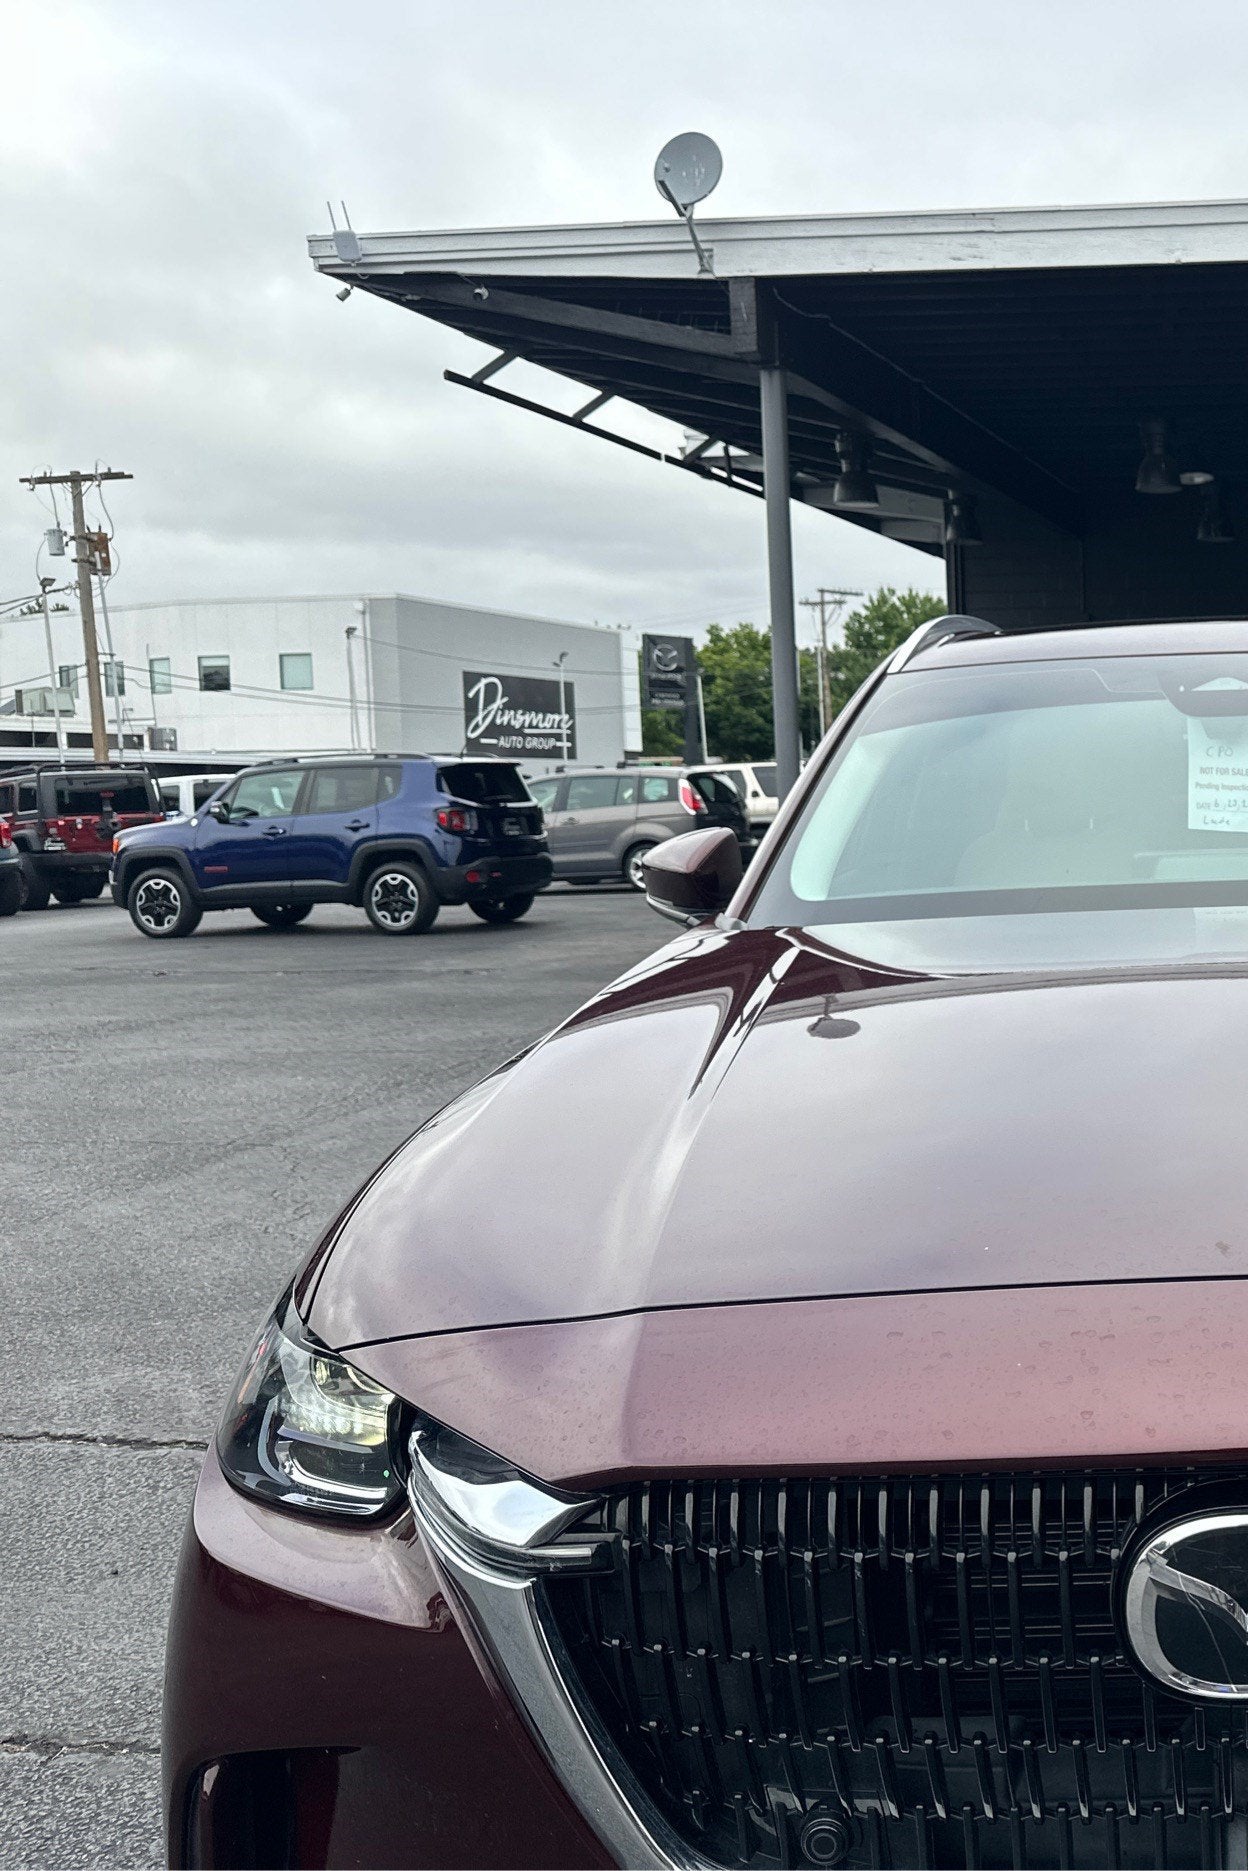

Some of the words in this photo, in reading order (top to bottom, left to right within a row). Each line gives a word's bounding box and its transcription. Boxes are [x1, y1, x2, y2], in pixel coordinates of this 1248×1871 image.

[467, 676, 574, 739] Dinsmore
[498, 735, 524, 749] AUTO
[525, 736, 556, 750] GROUP
[1200, 766, 1214, 775] NOT
[1215, 766, 1230, 776] FOR
[1195, 781, 1220, 791] Pending
